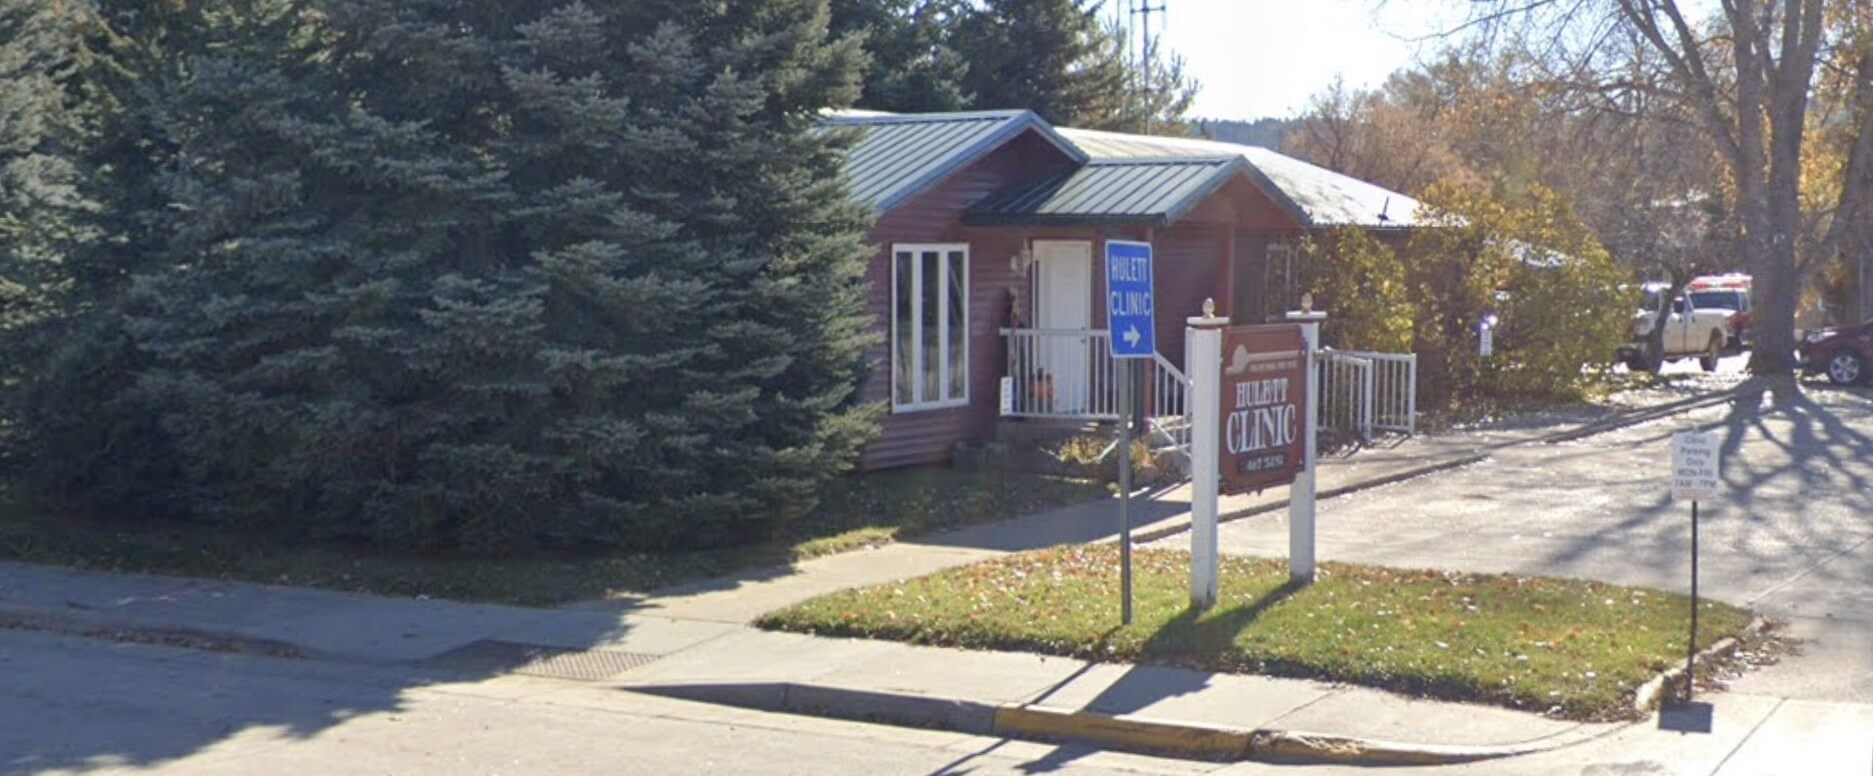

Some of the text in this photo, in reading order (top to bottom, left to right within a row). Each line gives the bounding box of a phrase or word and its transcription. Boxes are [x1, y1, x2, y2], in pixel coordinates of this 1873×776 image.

[1111, 255, 1147, 281] HULETT
[1111, 291, 1151, 315] CLINIC
[1235, 378, 1288, 409] HULETT
[1226, 404, 1297, 454] CLINIC
